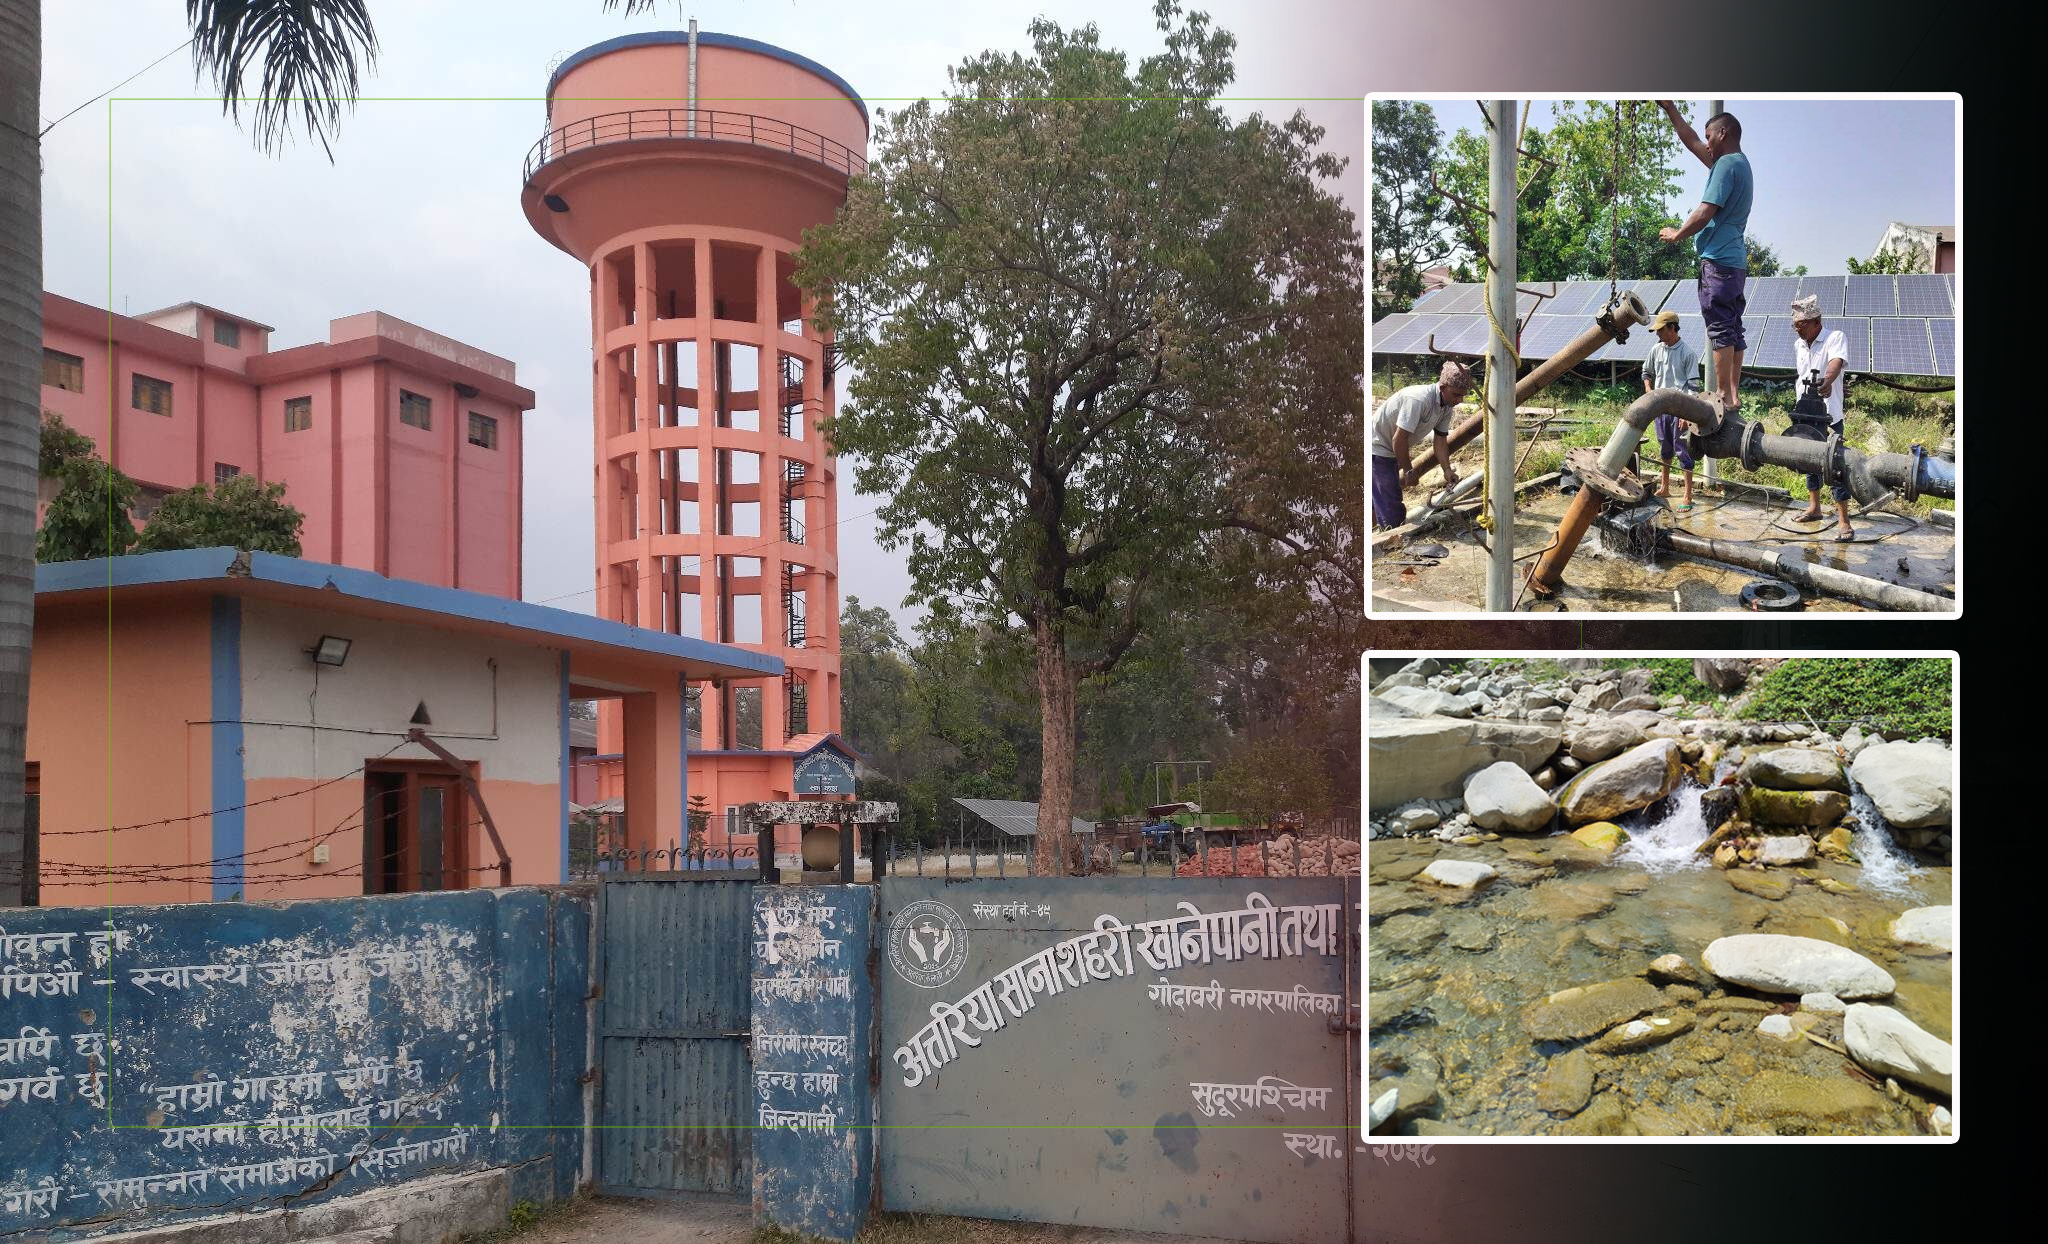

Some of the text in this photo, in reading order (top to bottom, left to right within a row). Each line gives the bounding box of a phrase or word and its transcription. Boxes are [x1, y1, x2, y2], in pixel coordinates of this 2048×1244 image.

[973, 901, 1001, 920] संस्था
[1148, 976, 1225, 1011] गोदावरी
[1230, 984, 1341, 1018] नगरपालिका
[1190, 1075, 1332, 1119] सुदूरपश्चिम
